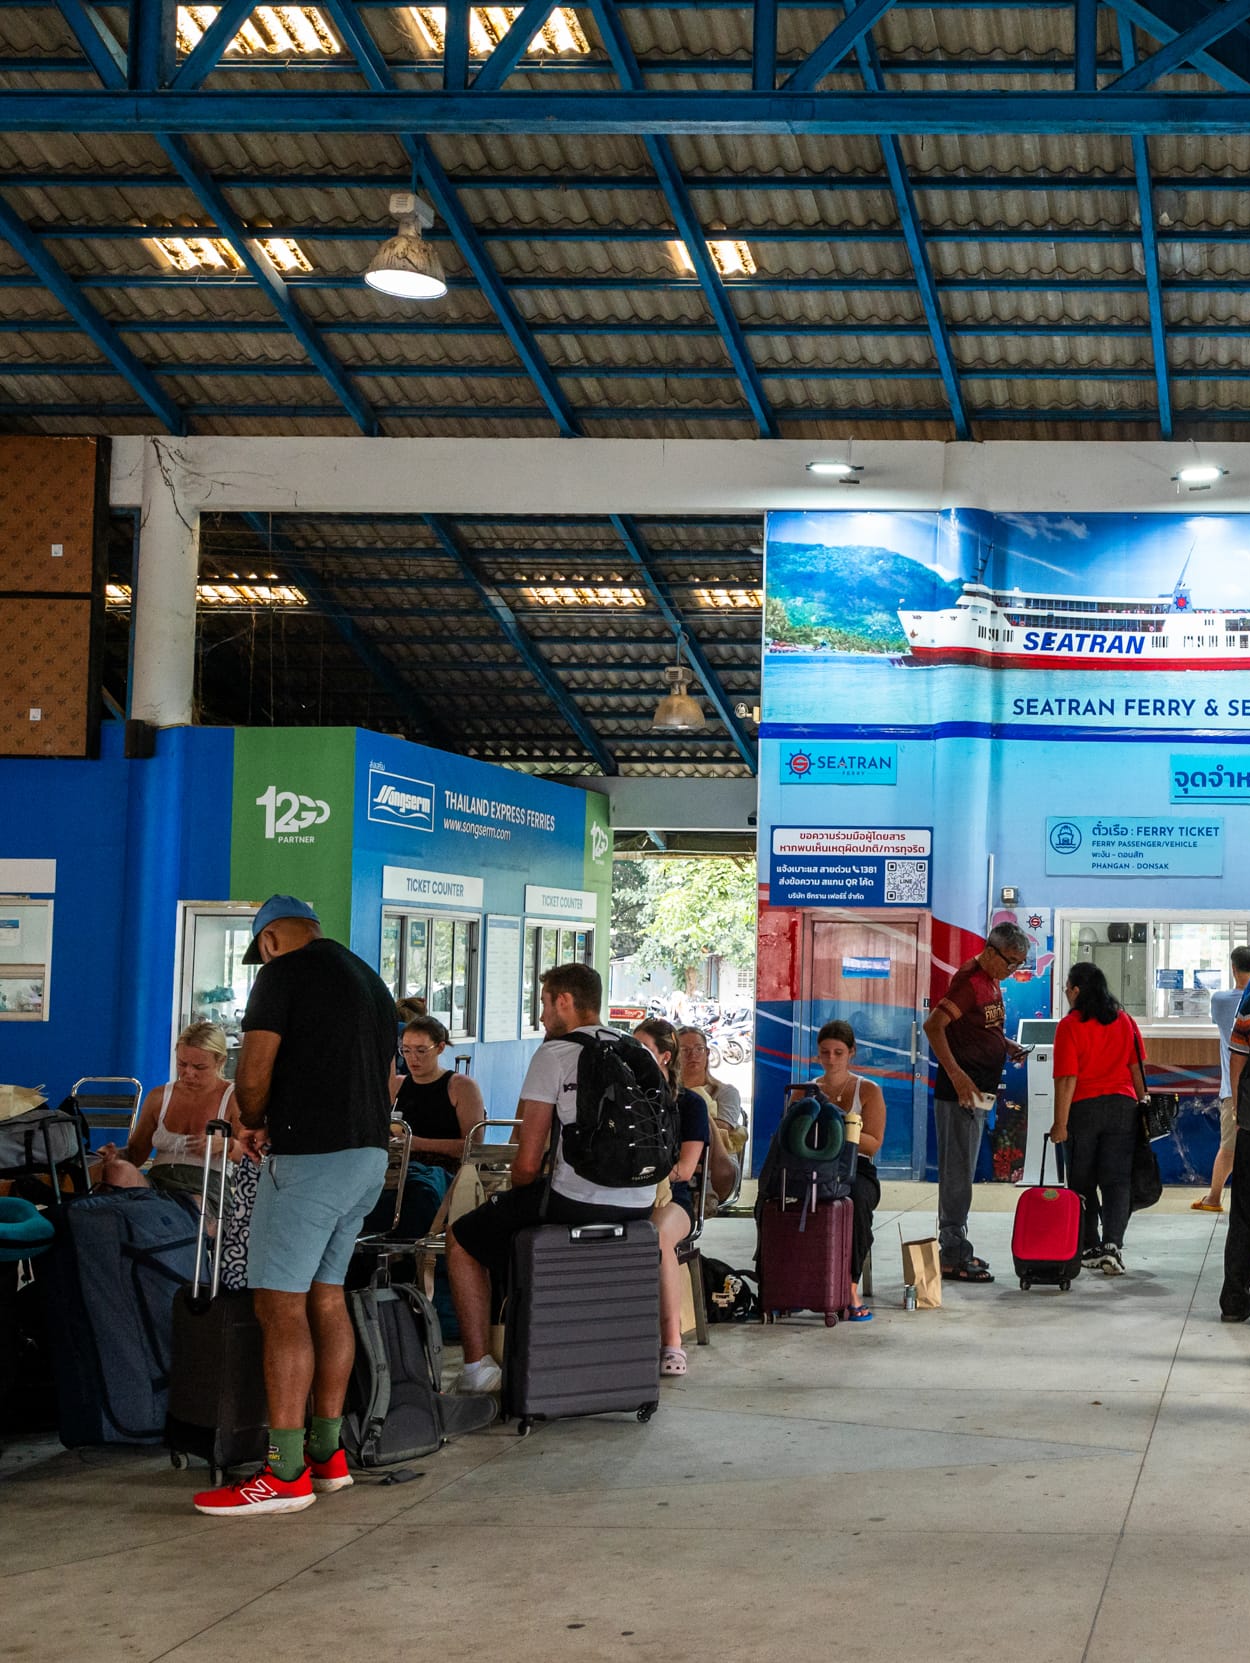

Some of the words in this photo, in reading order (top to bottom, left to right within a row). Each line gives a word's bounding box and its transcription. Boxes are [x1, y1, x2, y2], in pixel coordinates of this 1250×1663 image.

[1023, 630, 1145, 655] SEATRAN
[1012, 698, 1115, 717] SEATRAN
[1124, 699, 1196, 717] FERRY
[1204, 699, 1219, 717] &
[817, 756, 891, 769] SEATRAN
[444, 790, 489, 817] THAILAND
[490, 800, 526, 825] EXPRESS
[526, 809, 556, 832] FERRIES
[444, 818, 511, 841] www.songserm.com
[1092, 821, 1129, 836] ตั๋วเรือ
[1136, 826, 1174, 837] FERRY
[1178, 826, 1220, 837] TICKET
[278, 836, 315, 844] PARTNER
[800, 830, 906, 843] ขอความร่วมมือผู้โดยสาร
[780, 843, 925, 856] หากพบเห็นเหตุผิดปกติ/การทุจริต
[1118, 840, 1198, 848] PASSENGER/VEHICLE
[776, 864, 818, 873] แจ้งเบาะแส
[820, 864, 851, 873] สายด่วน
[860, 866, 877, 874] 1381
[406, 878, 431, 893] TICKET
[432, 881, 465, 898] COUNTER
[778, 876, 821, 886] ส่งข้อความ
[822, 878, 845, 886] สแกน
[846, 878, 858, 887] QR
[542, 894, 559, 905] TICKET
[560, 896, 584, 909] COUNTER
